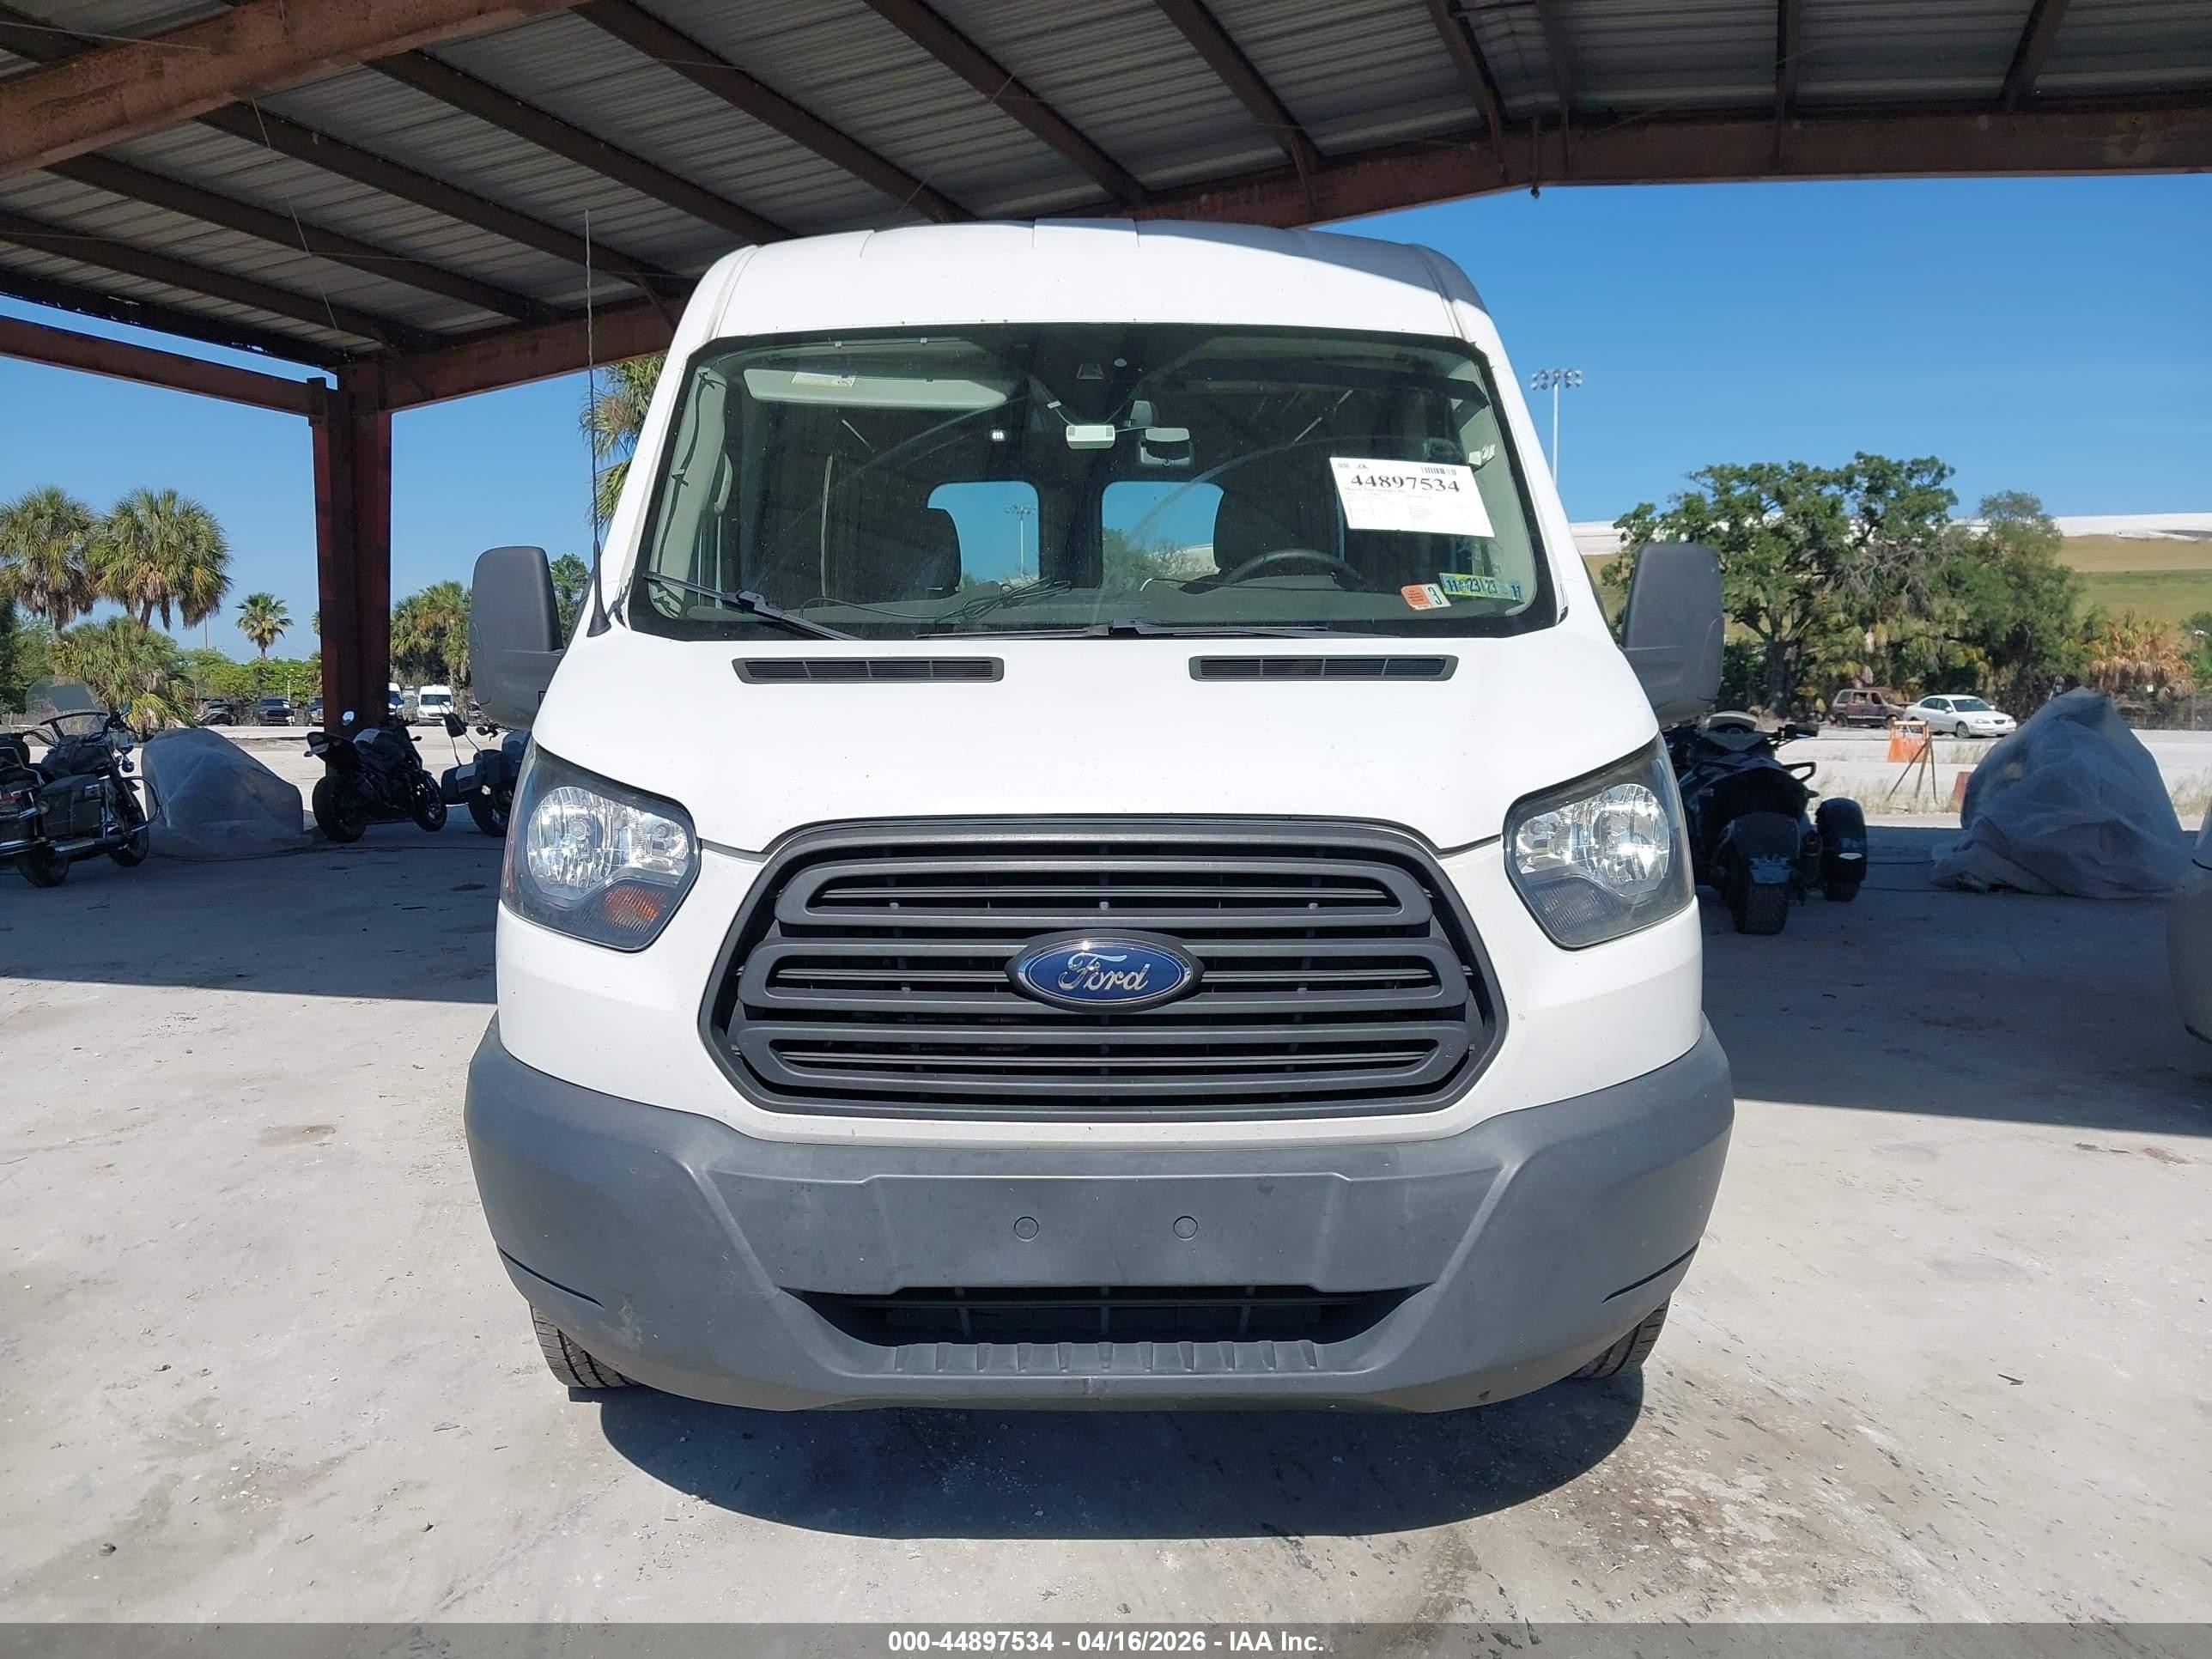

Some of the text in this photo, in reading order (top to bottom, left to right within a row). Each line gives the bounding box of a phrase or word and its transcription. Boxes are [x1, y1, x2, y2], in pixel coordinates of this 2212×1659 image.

[1350, 474, 1461, 493] 44897534
[1427, 586, 1443, 605] 3
[1057, 952, 1152, 991] Ford
